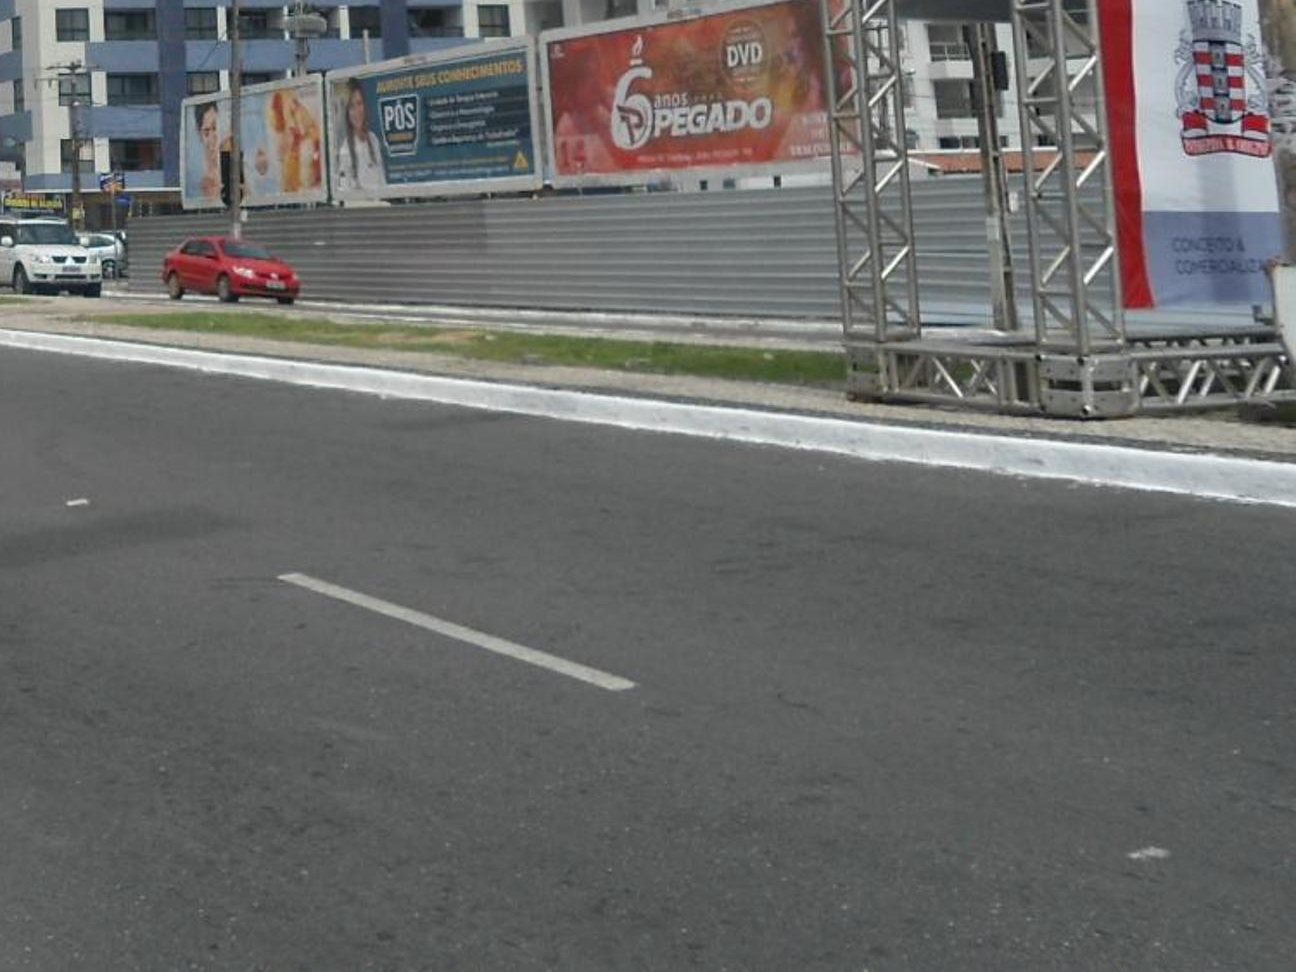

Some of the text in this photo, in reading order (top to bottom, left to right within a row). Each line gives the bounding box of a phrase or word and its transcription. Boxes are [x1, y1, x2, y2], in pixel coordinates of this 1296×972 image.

[726, 41, 763, 68] DVD
[383, 98, 416, 131] PÓS
[611, 66, 689, 150] 6 anos
[653, 96, 772, 138] PEGADO
